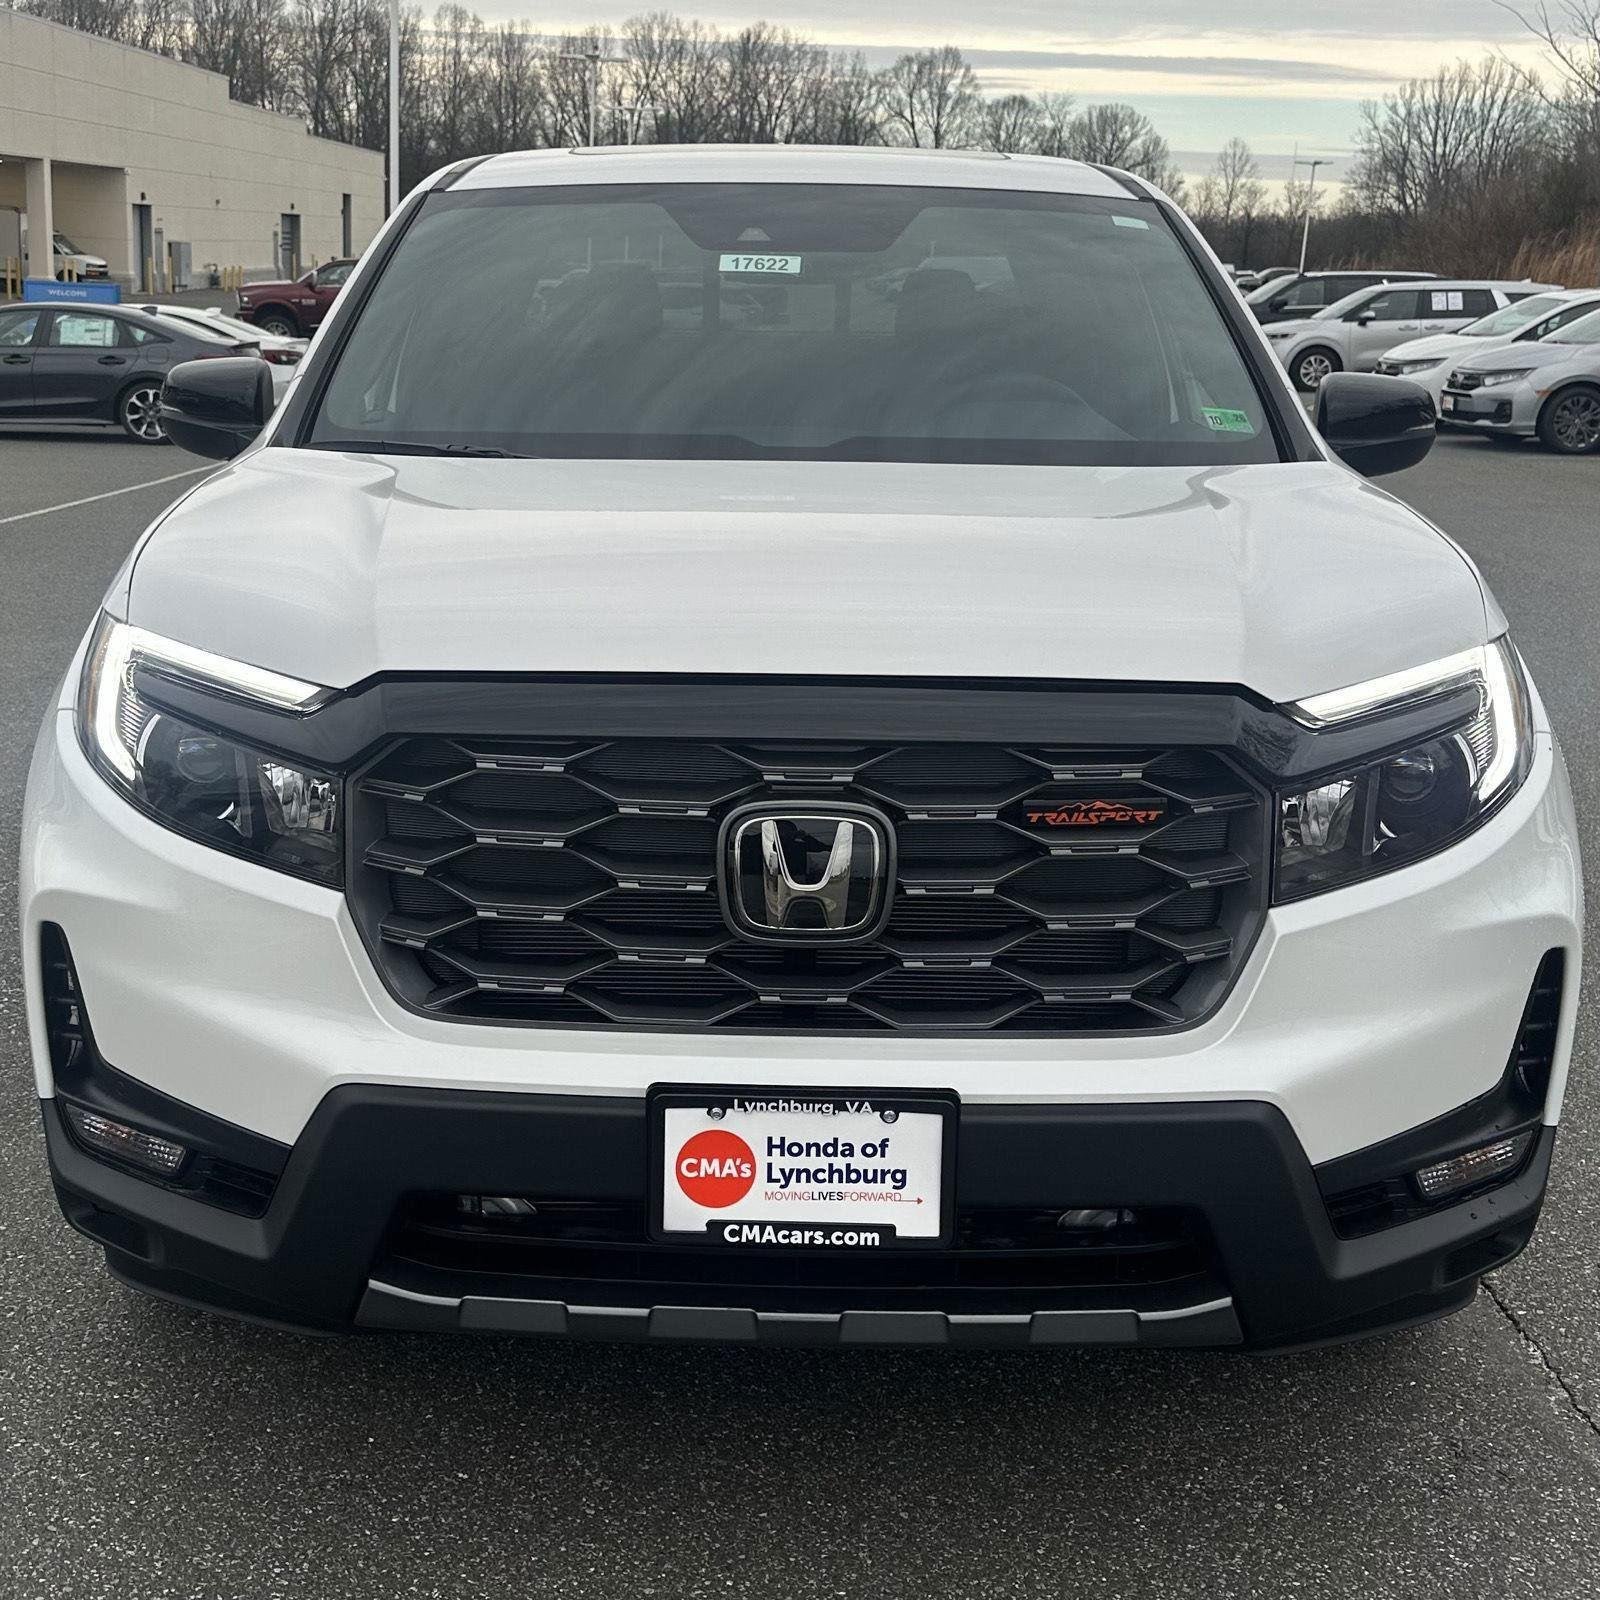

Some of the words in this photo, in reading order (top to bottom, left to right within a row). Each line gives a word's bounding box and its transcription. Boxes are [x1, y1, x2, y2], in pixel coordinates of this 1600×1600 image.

[731, 257, 789, 271] 17622
[48, 289, 87, 297] WELCOME
[1208, 415, 1223, 426] 10
[1026, 810, 1164, 825] TRAILSPORT
[733, 1098, 839, 1116] Lynchburg,
[845, 1101, 874, 1114] VA
[766, 1136, 855, 1158] Honda
[861, 1137, 890, 1158] of
[680, 1157, 752, 1178] CMA's
[766, 1162, 908, 1190] Lynchburg
[723, 1224, 881, 1246] CMAcars.com
